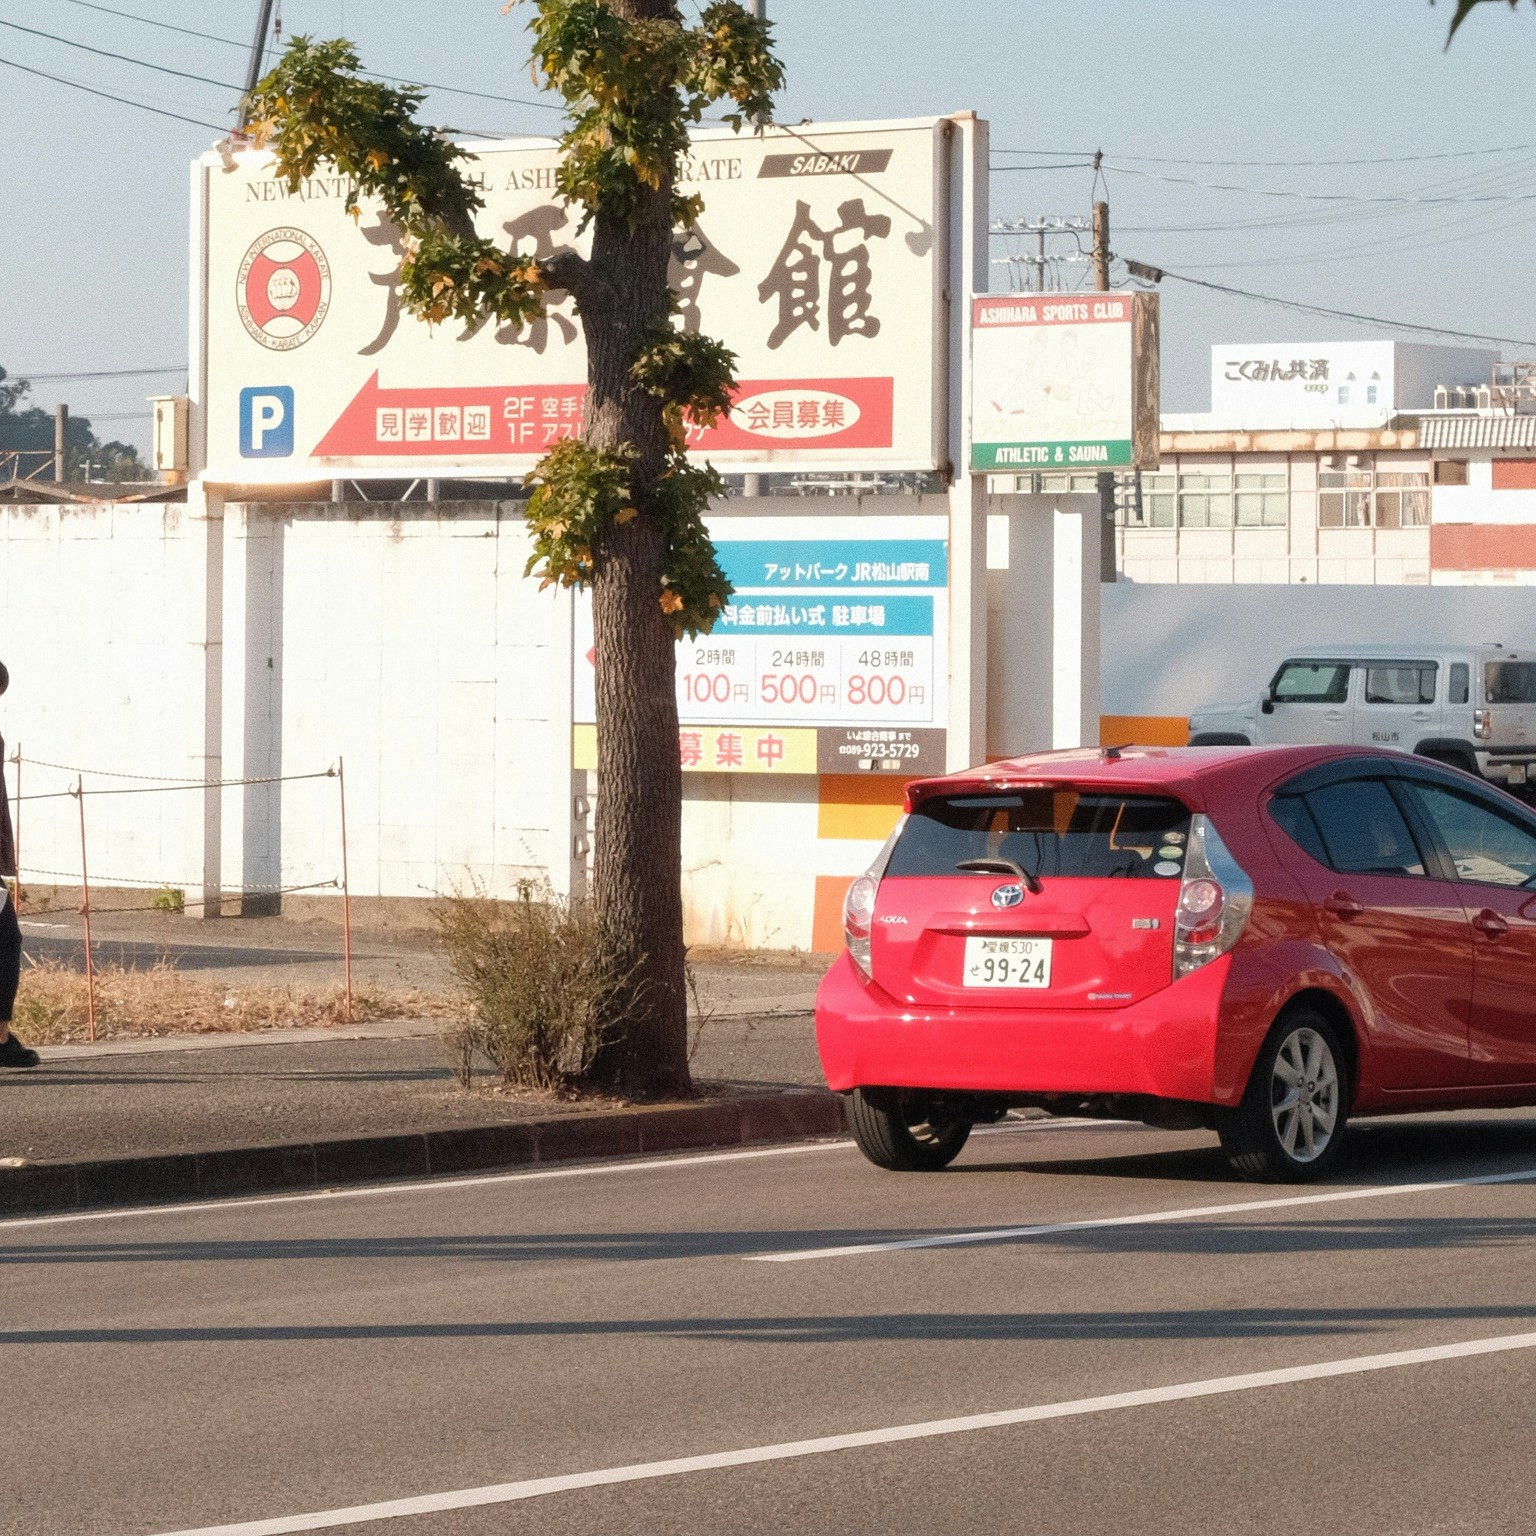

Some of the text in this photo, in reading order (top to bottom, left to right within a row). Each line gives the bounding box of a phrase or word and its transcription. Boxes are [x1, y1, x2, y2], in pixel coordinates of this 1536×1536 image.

[790, 154, 861, 175] SABAKI
[248, 229, 308, 261] INTERNATIONAL
[308, 241, 330, 282] KARATE
[239, 304, 268, 345] ASHIHARA
[304, 300, 328, 337] KAIKAN
[979, 302, 1124, 324] ASHIHARA SPORTS CLUB
[1225, 358, 1330, 382] こくみん共済
[503, 397, 536, 418] 2F
[747, 399, 846, 431] 会員募集
[251, 395, 285, 450] P
[380, 412, 487, 437] 見学歓迎
[507, 422, 536, 444] 1F
[994, 445, 1109, 463] ATHLETIC & SAUNA
[850, 561, 931, 582] JR松山駅南
[831, 604, 886, 627] 駐車場
[695, 648, 735, 666] 2時間
[772, 650, 825, 668] 24時間
[858, 650, 914, 668] 48時間
[683, 672, 749, 703] 100円
[761, 673, 836, 704] 500円
[847, 674, 925, 705] 800円
[679, 732, 783, 768] 募集中
[984, 957, 1045, 983] 99-24
